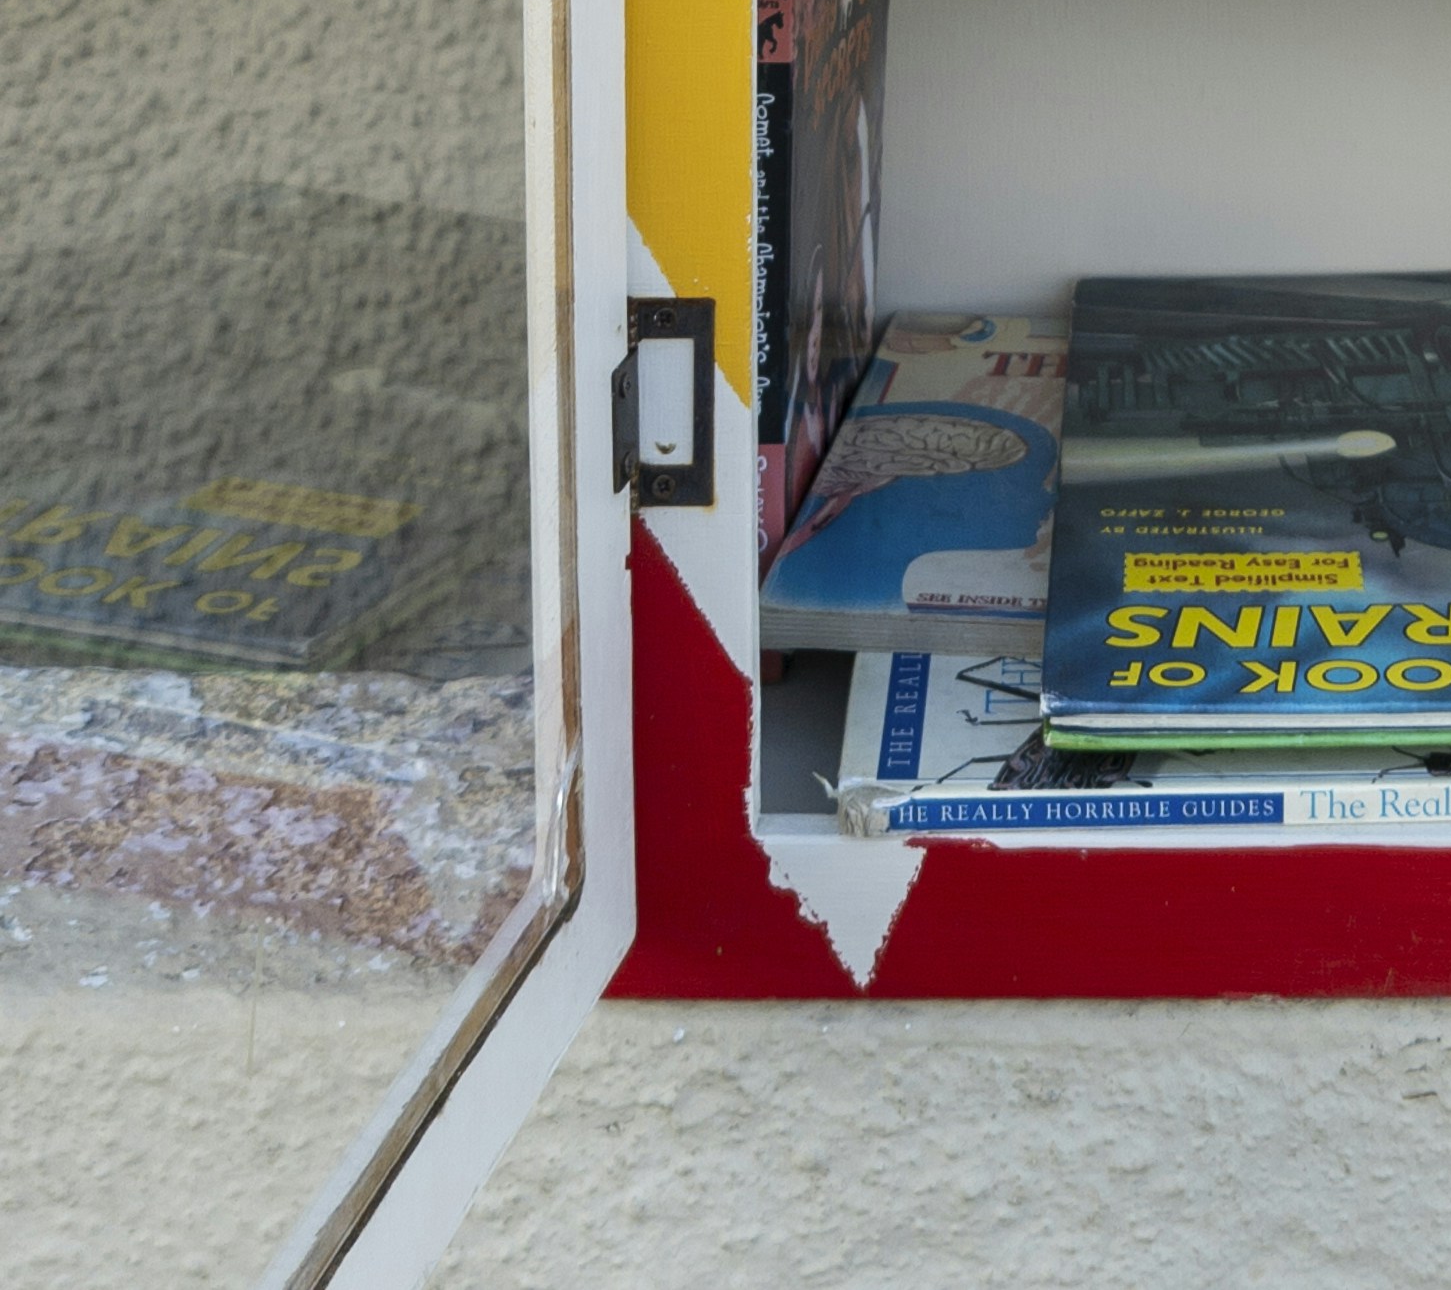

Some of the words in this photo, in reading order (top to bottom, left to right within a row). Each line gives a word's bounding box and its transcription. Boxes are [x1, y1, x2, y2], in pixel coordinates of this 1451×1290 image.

[1100, 508, 1165, 518] ZAFFO
[1201, 508, 1286, 518] GEORGE
[1100, 525, 1125, 535] BY
[1137, 525, 1264, 535] ILLUSTRATED
[1133, 557, 1236, 571] Reading
[1247, 557, 1303, 570] Easy
[1310, 559, 1350, 570] For
[1146, 572, 1199, 587] Text
[1215, 572, 1339, 587] Simplified
[916, 592, 953, 605] SEE
[956, 594, 1025, 608] INSIDE
[1109, 658, 1207, 689] OF
[888, 727, 914, 768] THE
[941, 802, 1034, 822] REALLY
[1047, 800, 1171, 820] HORRIBLE
[1182, 798, 1276, 817] GUIDES
[1301, 790, 1366, 819] The
